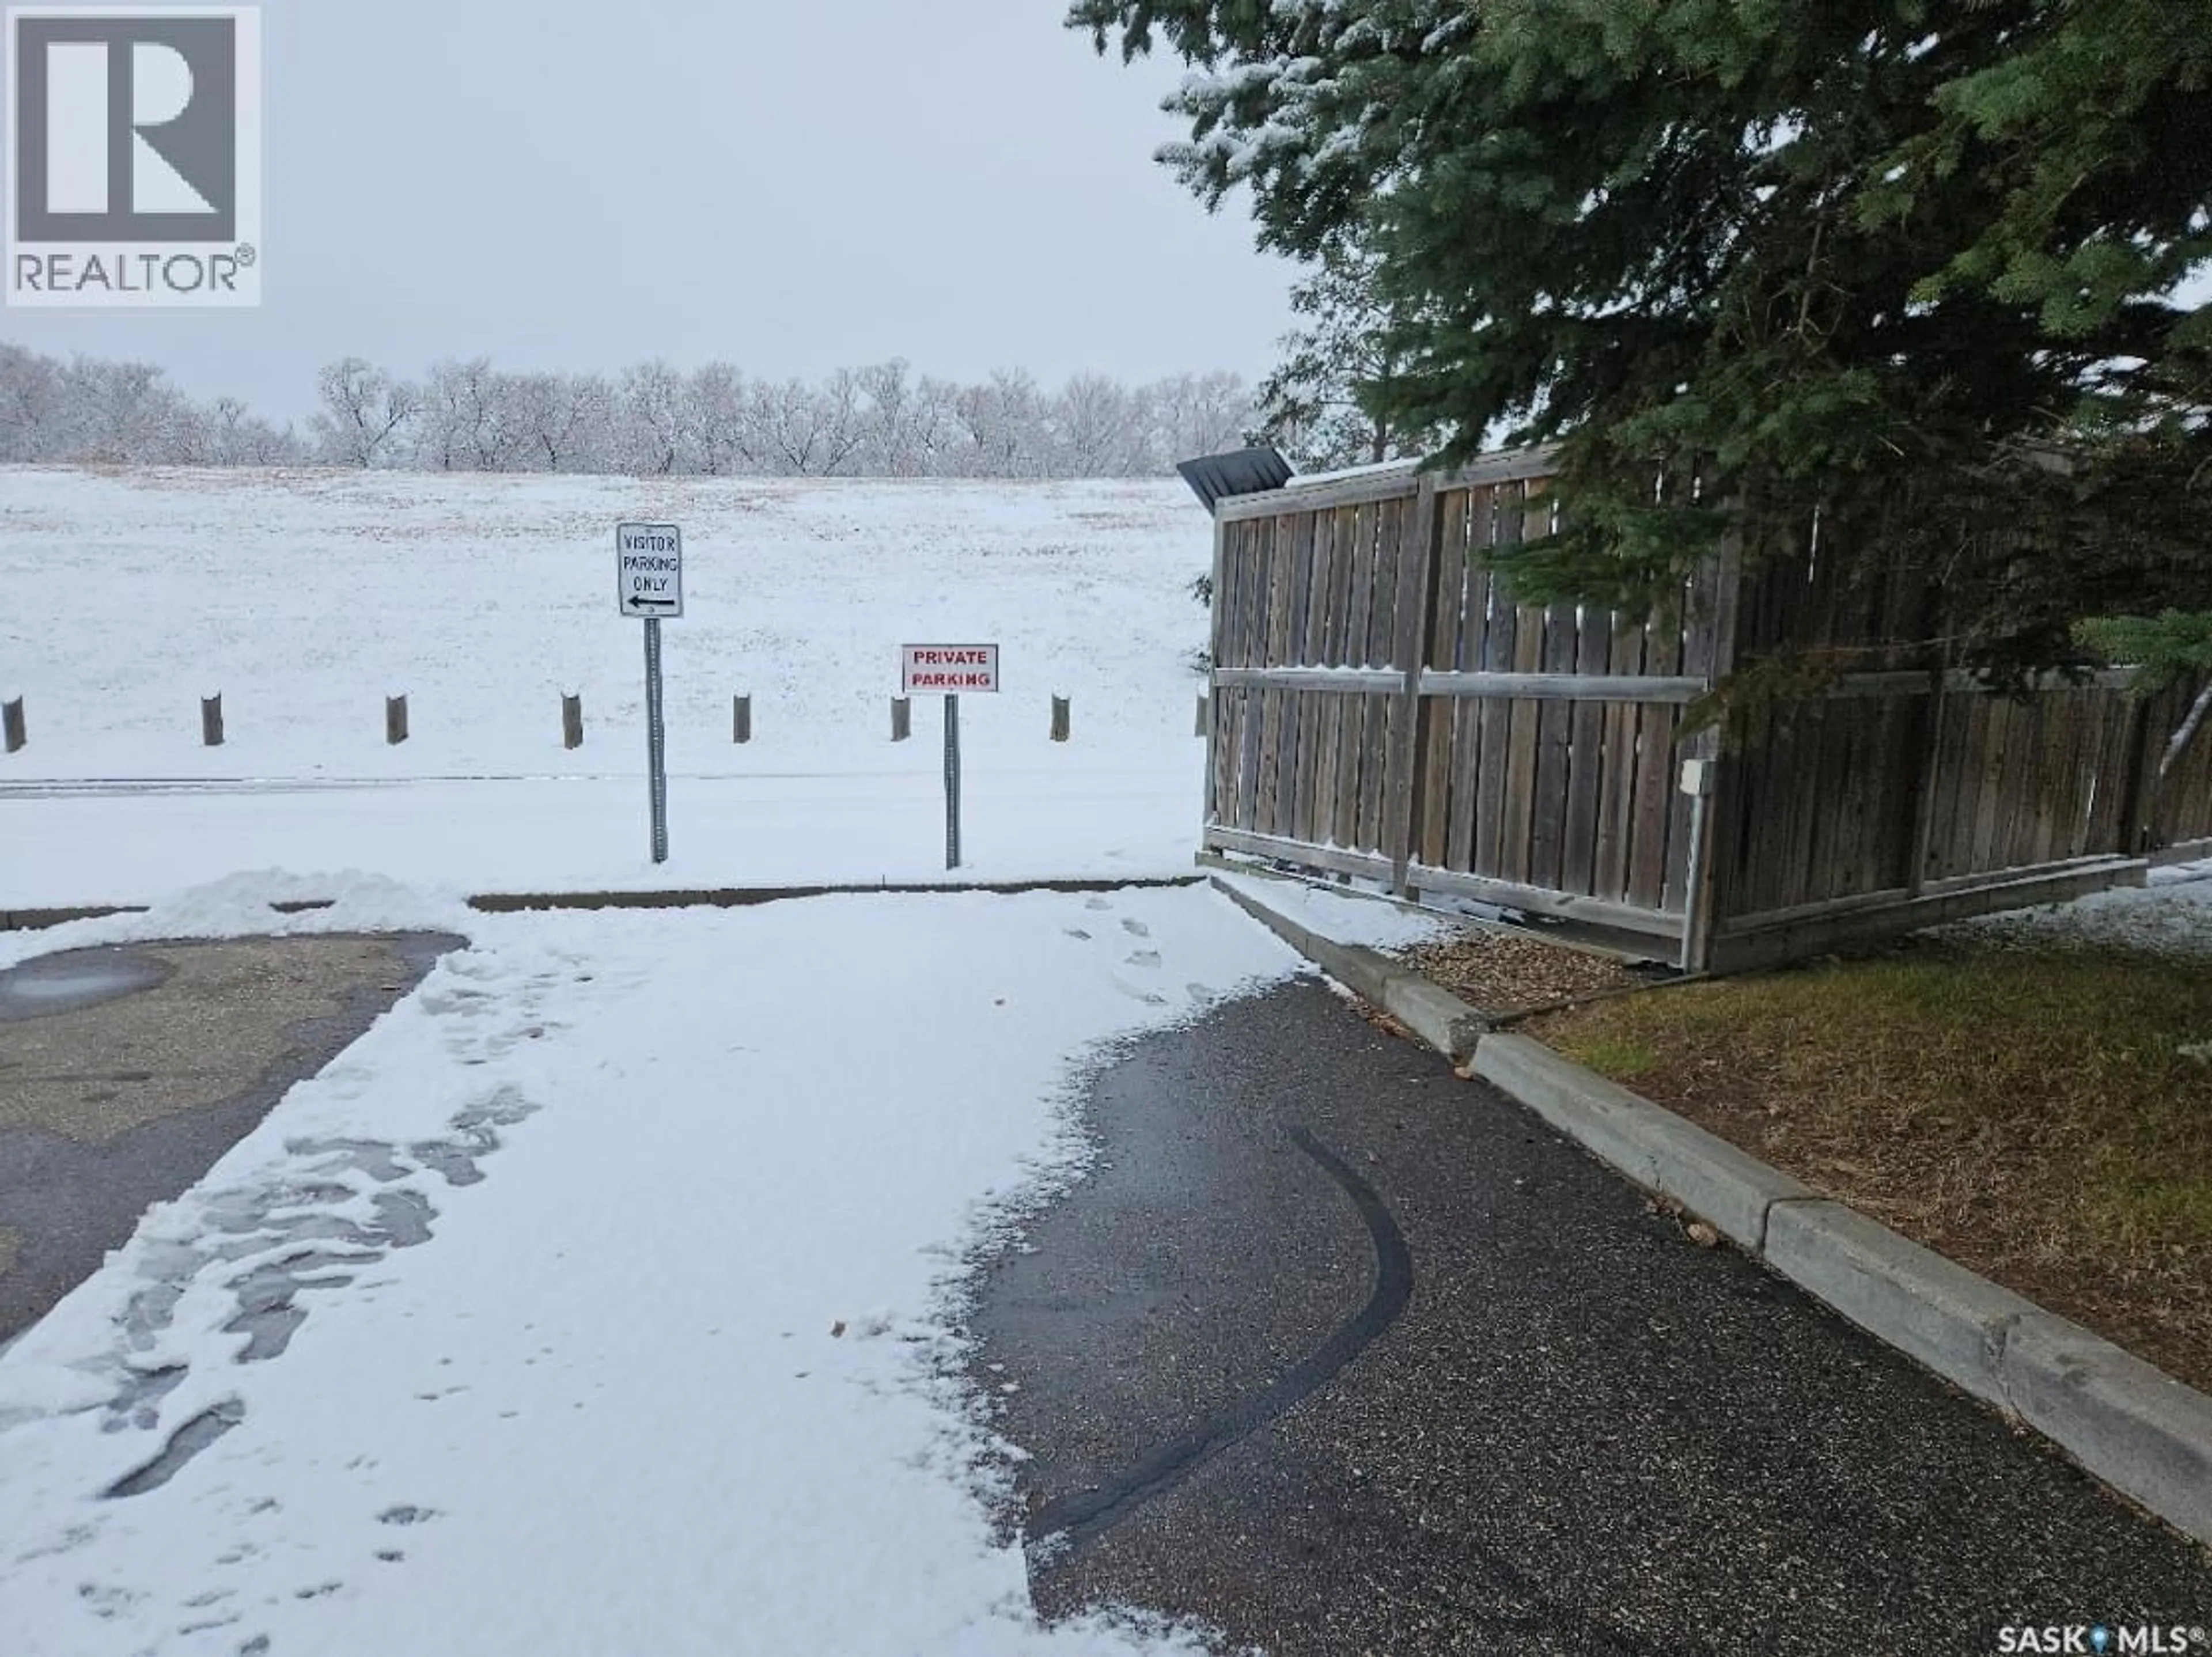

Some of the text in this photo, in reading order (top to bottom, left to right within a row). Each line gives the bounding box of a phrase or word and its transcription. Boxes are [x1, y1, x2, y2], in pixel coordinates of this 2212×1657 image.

[624, 534, 675, 551] VISITOR
[624, 556, 676, 571] PARKING
[634, 576, 668, 591] ONLY
[914, 651, 987, 664] PRIVATE
[912, 673, 990, 685] PARKING
